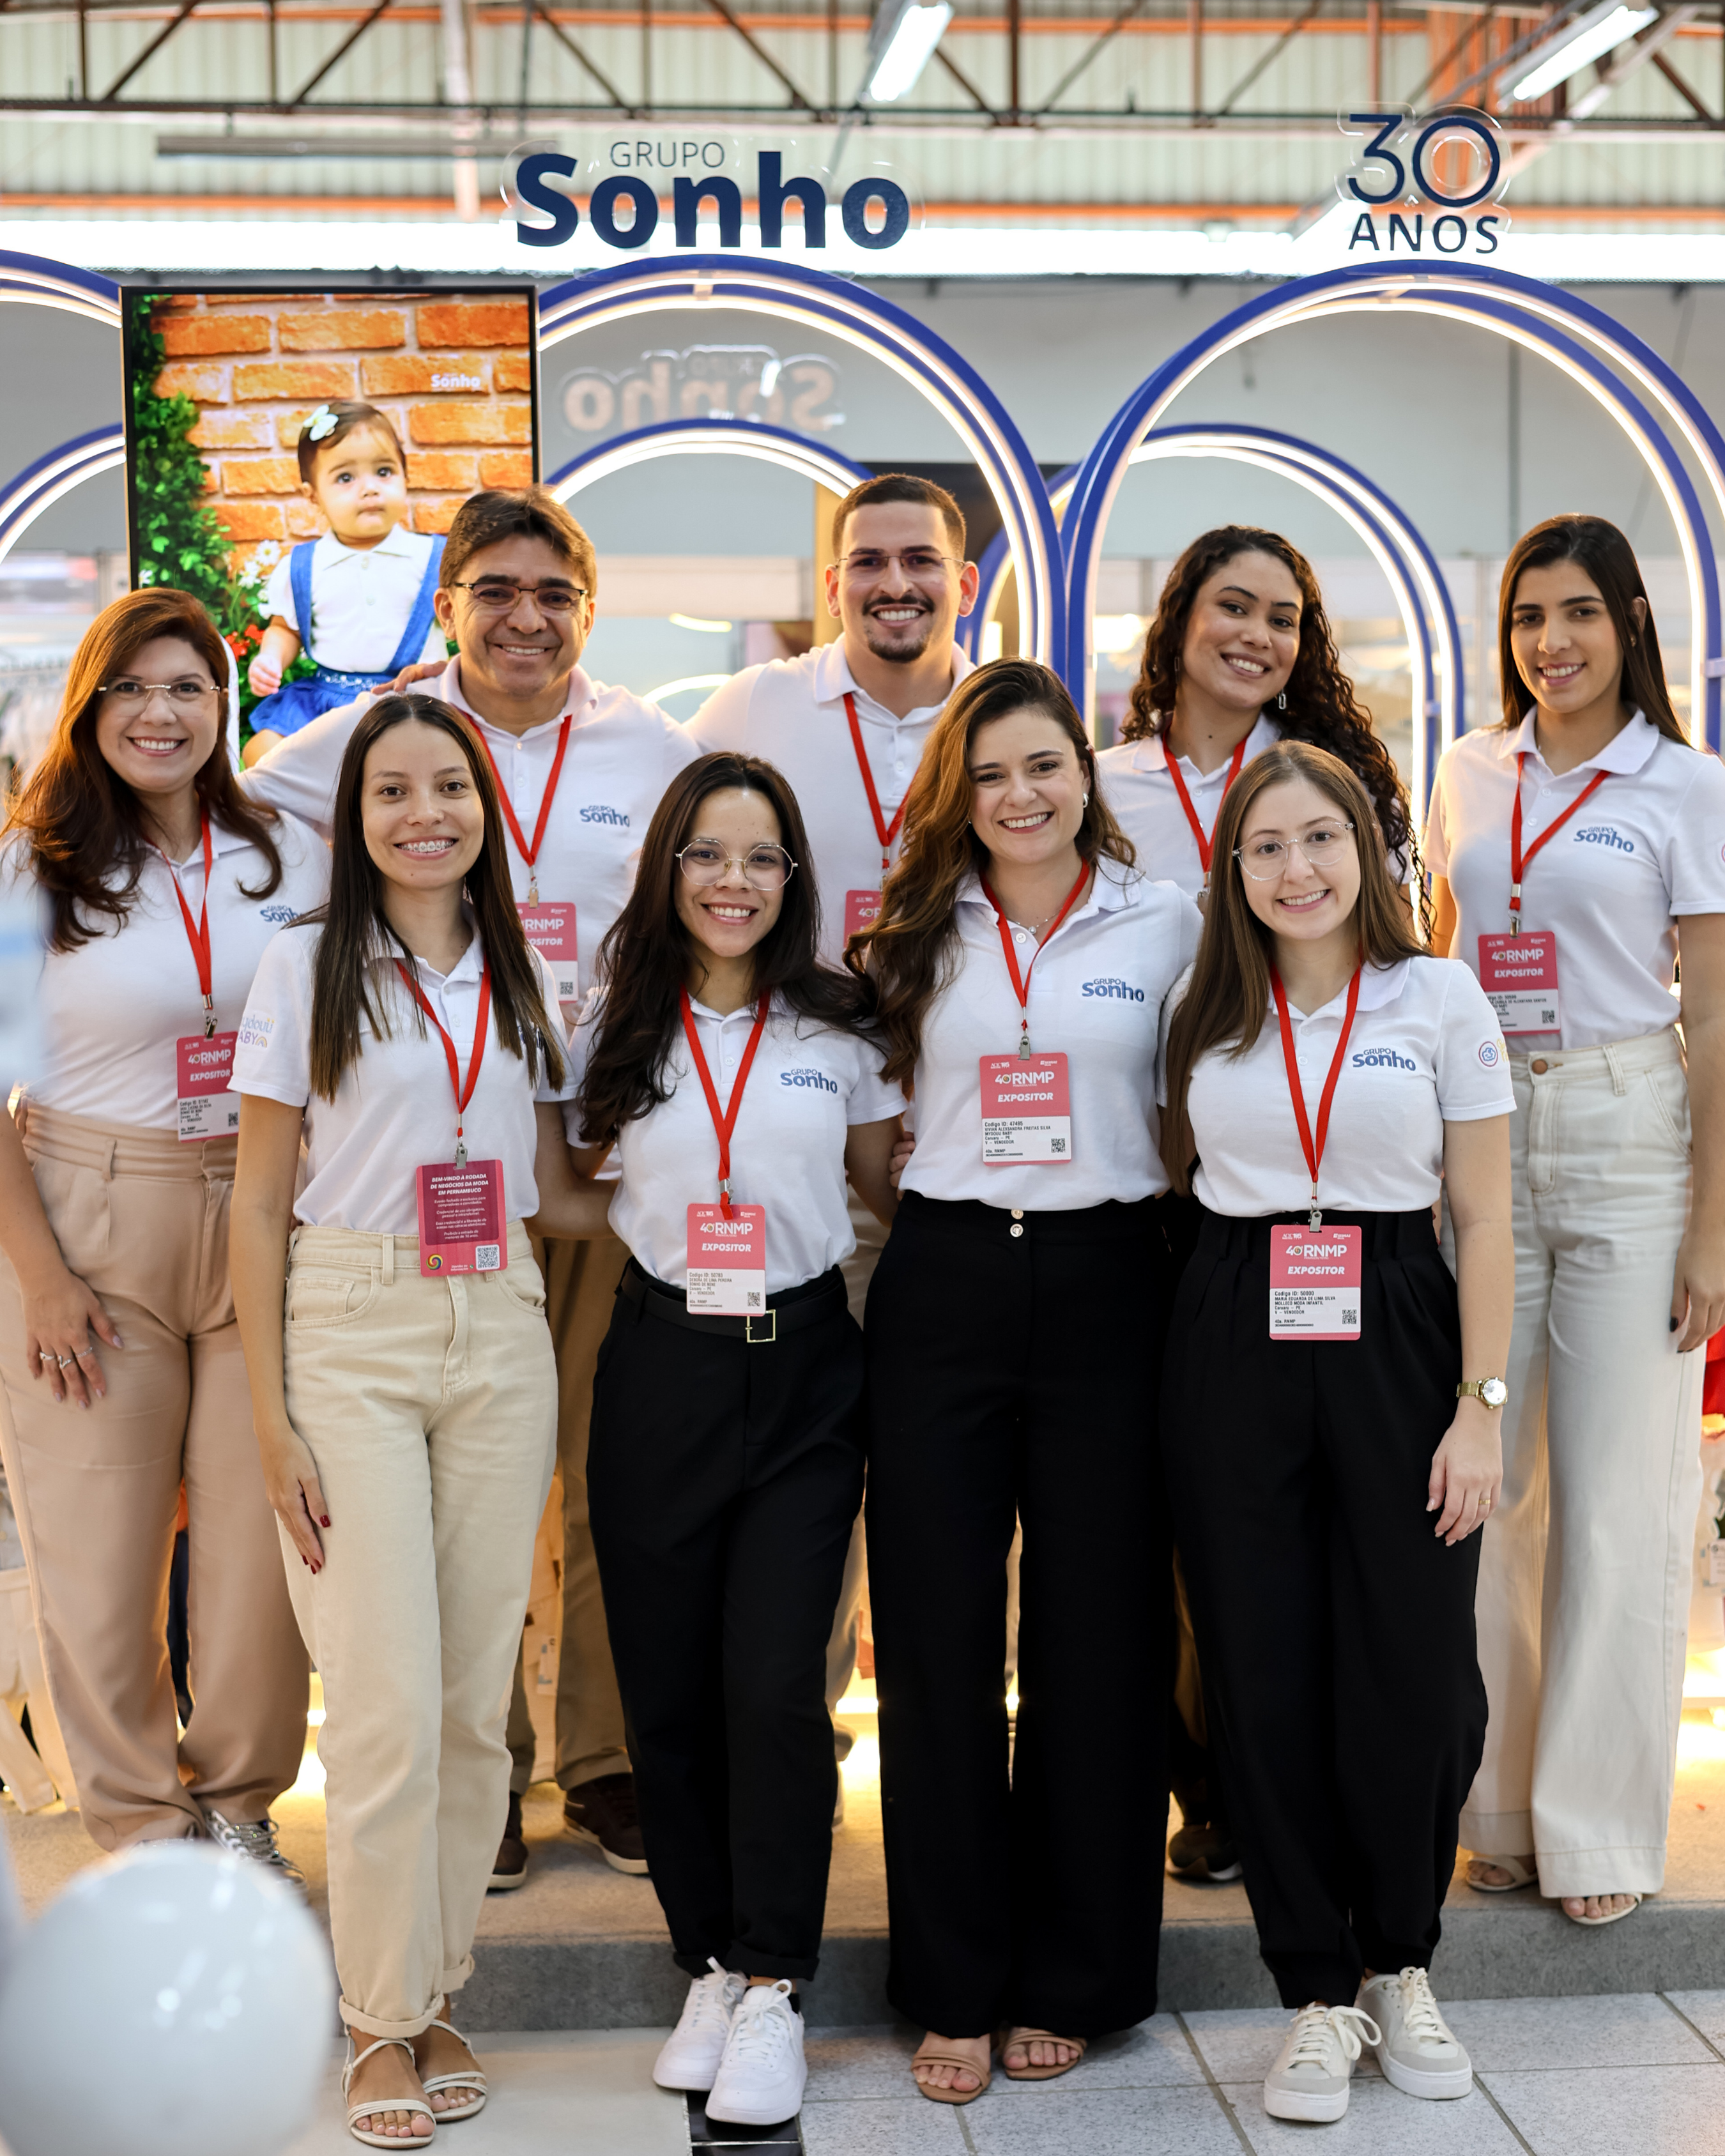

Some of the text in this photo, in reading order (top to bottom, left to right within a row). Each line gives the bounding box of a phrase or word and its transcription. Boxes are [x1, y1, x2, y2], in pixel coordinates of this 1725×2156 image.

[610, 141, 726, 169] GRUPO
[1347, 113, 1500, 208] 30
[515, 150, 910, 250] Sonho
[1347, 212, 1499, 254] ANOS
[431, 373, 480, 388] Sonho
[579, 808, 630, 828] Sonho
[1573, 829, 1634, 853] Sonho
[259, 907, 299, 922] Sonh
[525, 918, 565, 930] RNMP
[528, 937, 564, 945] OSITOR
[1506, 948, 1544, 962] RNMP
[1494, 967, 1544, 978] EXPOSITOR
[1082, 981, 1144, 1002] Sonho
[238, 1030, 259, 1045] ABY
[201, 1048, 232, 1065] RNMP
[1352, 1050, 1416, 1071] Sonho
[190, 1068, 231, 1082] EXPOSITOR
[1012, 1071, 1055, 1085] RNMP
[780, 1072, 838, 1094] Sonho
[997, 1092, 1054, 1103] EXPOSITOR
[715, 1221, 753, 1235] RNMP
[702, 1242, 752, 1252] EXPOSITOR
[1303, 1244, 1347, 1257] RNMP
[1287, 1266, 1345, 1275] EXPOSITOR
